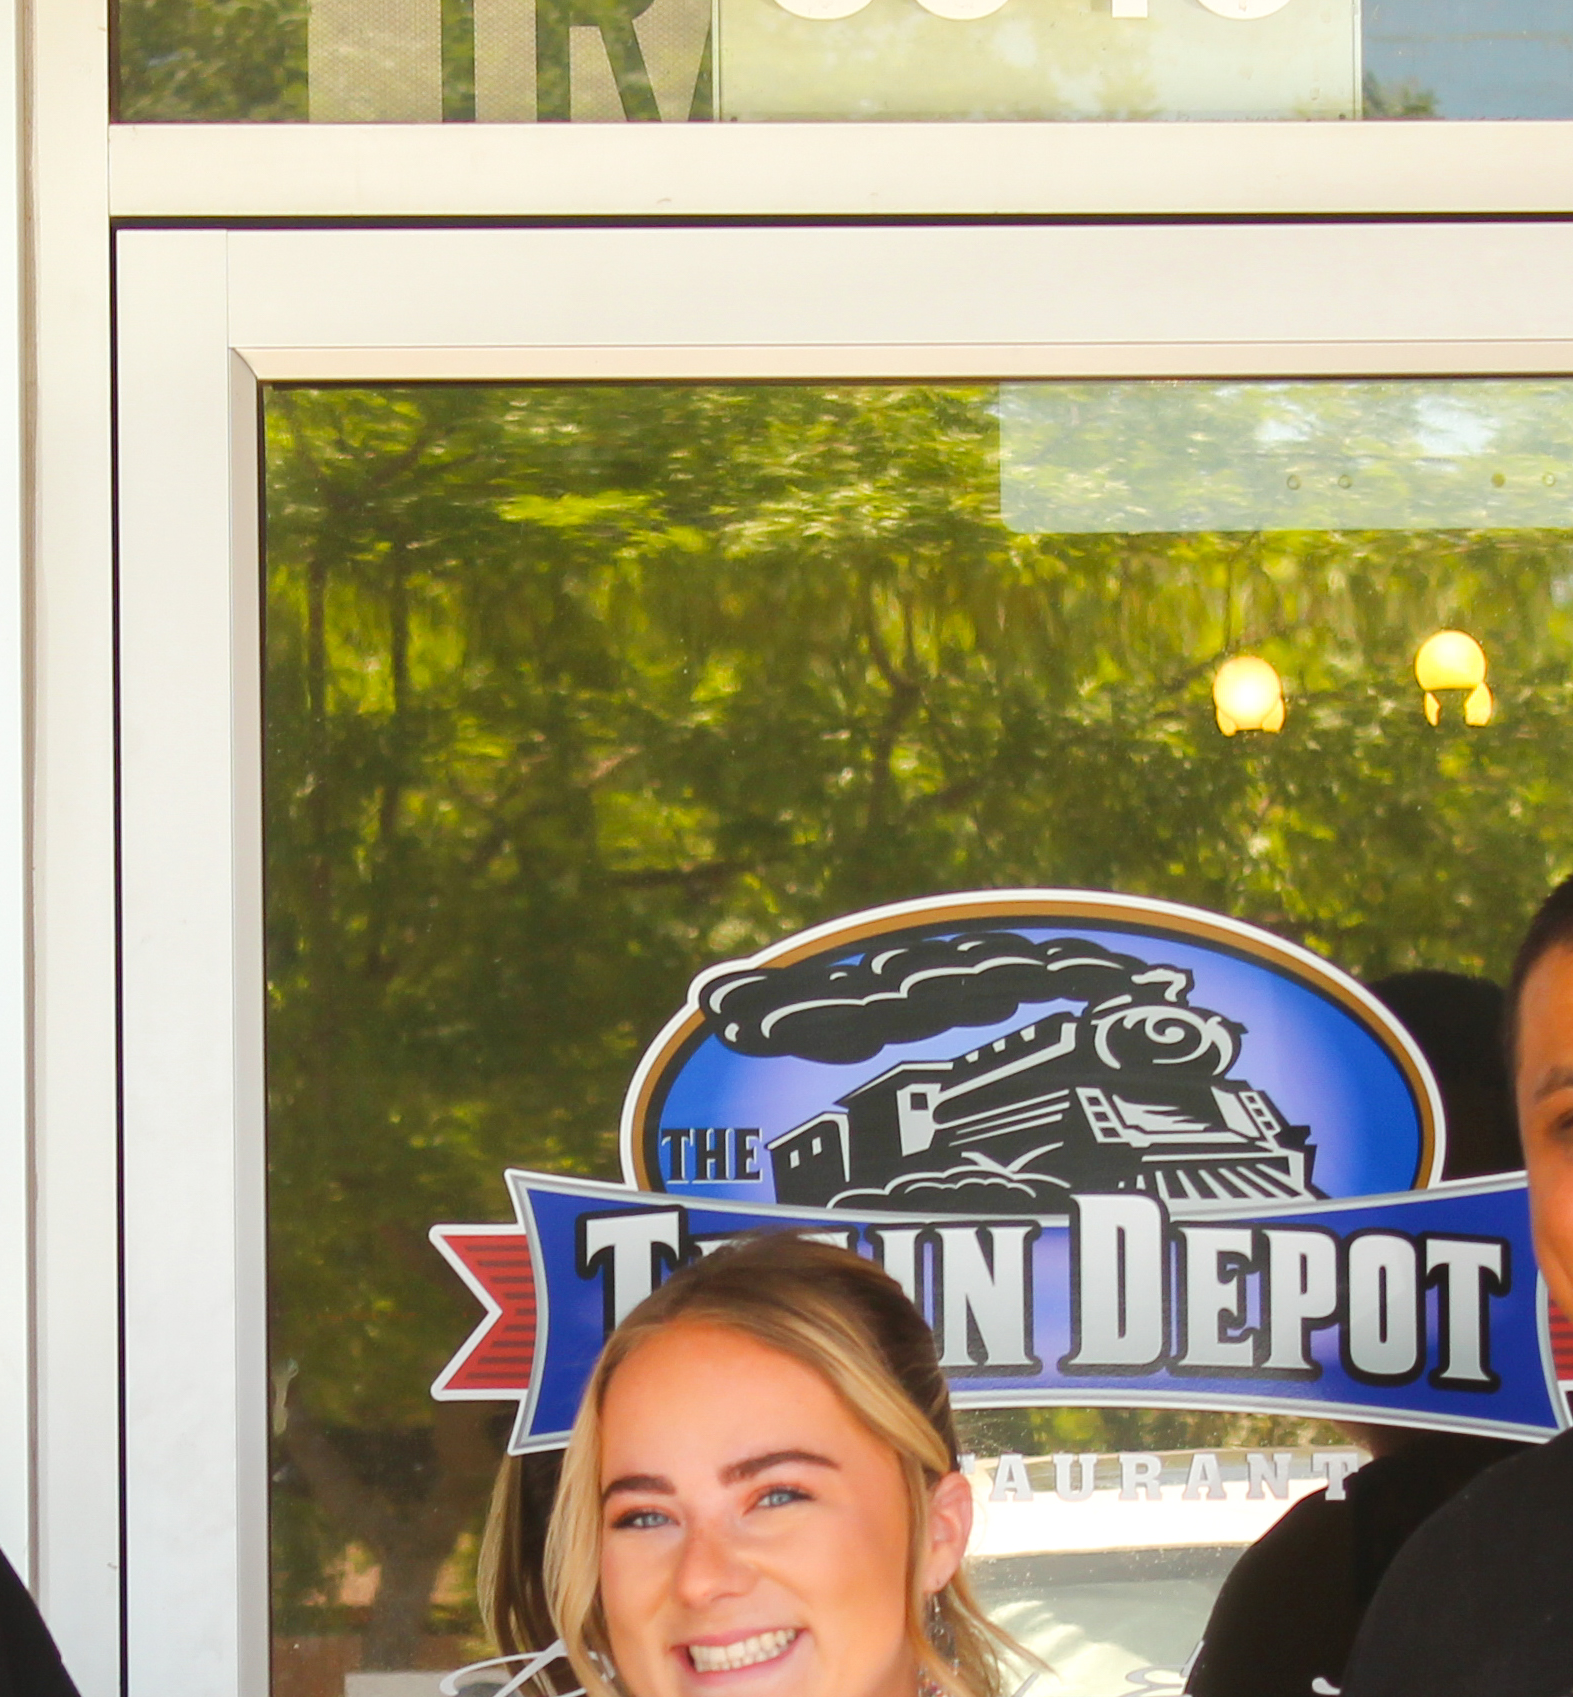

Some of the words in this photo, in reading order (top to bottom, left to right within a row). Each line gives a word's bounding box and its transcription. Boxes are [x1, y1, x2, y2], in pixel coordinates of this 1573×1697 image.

[659, 1127, 764, 1186] THE
[582, 1208, 1036, 1368] TIN
[1069, 1193, 1514, 1382] DEPOT
